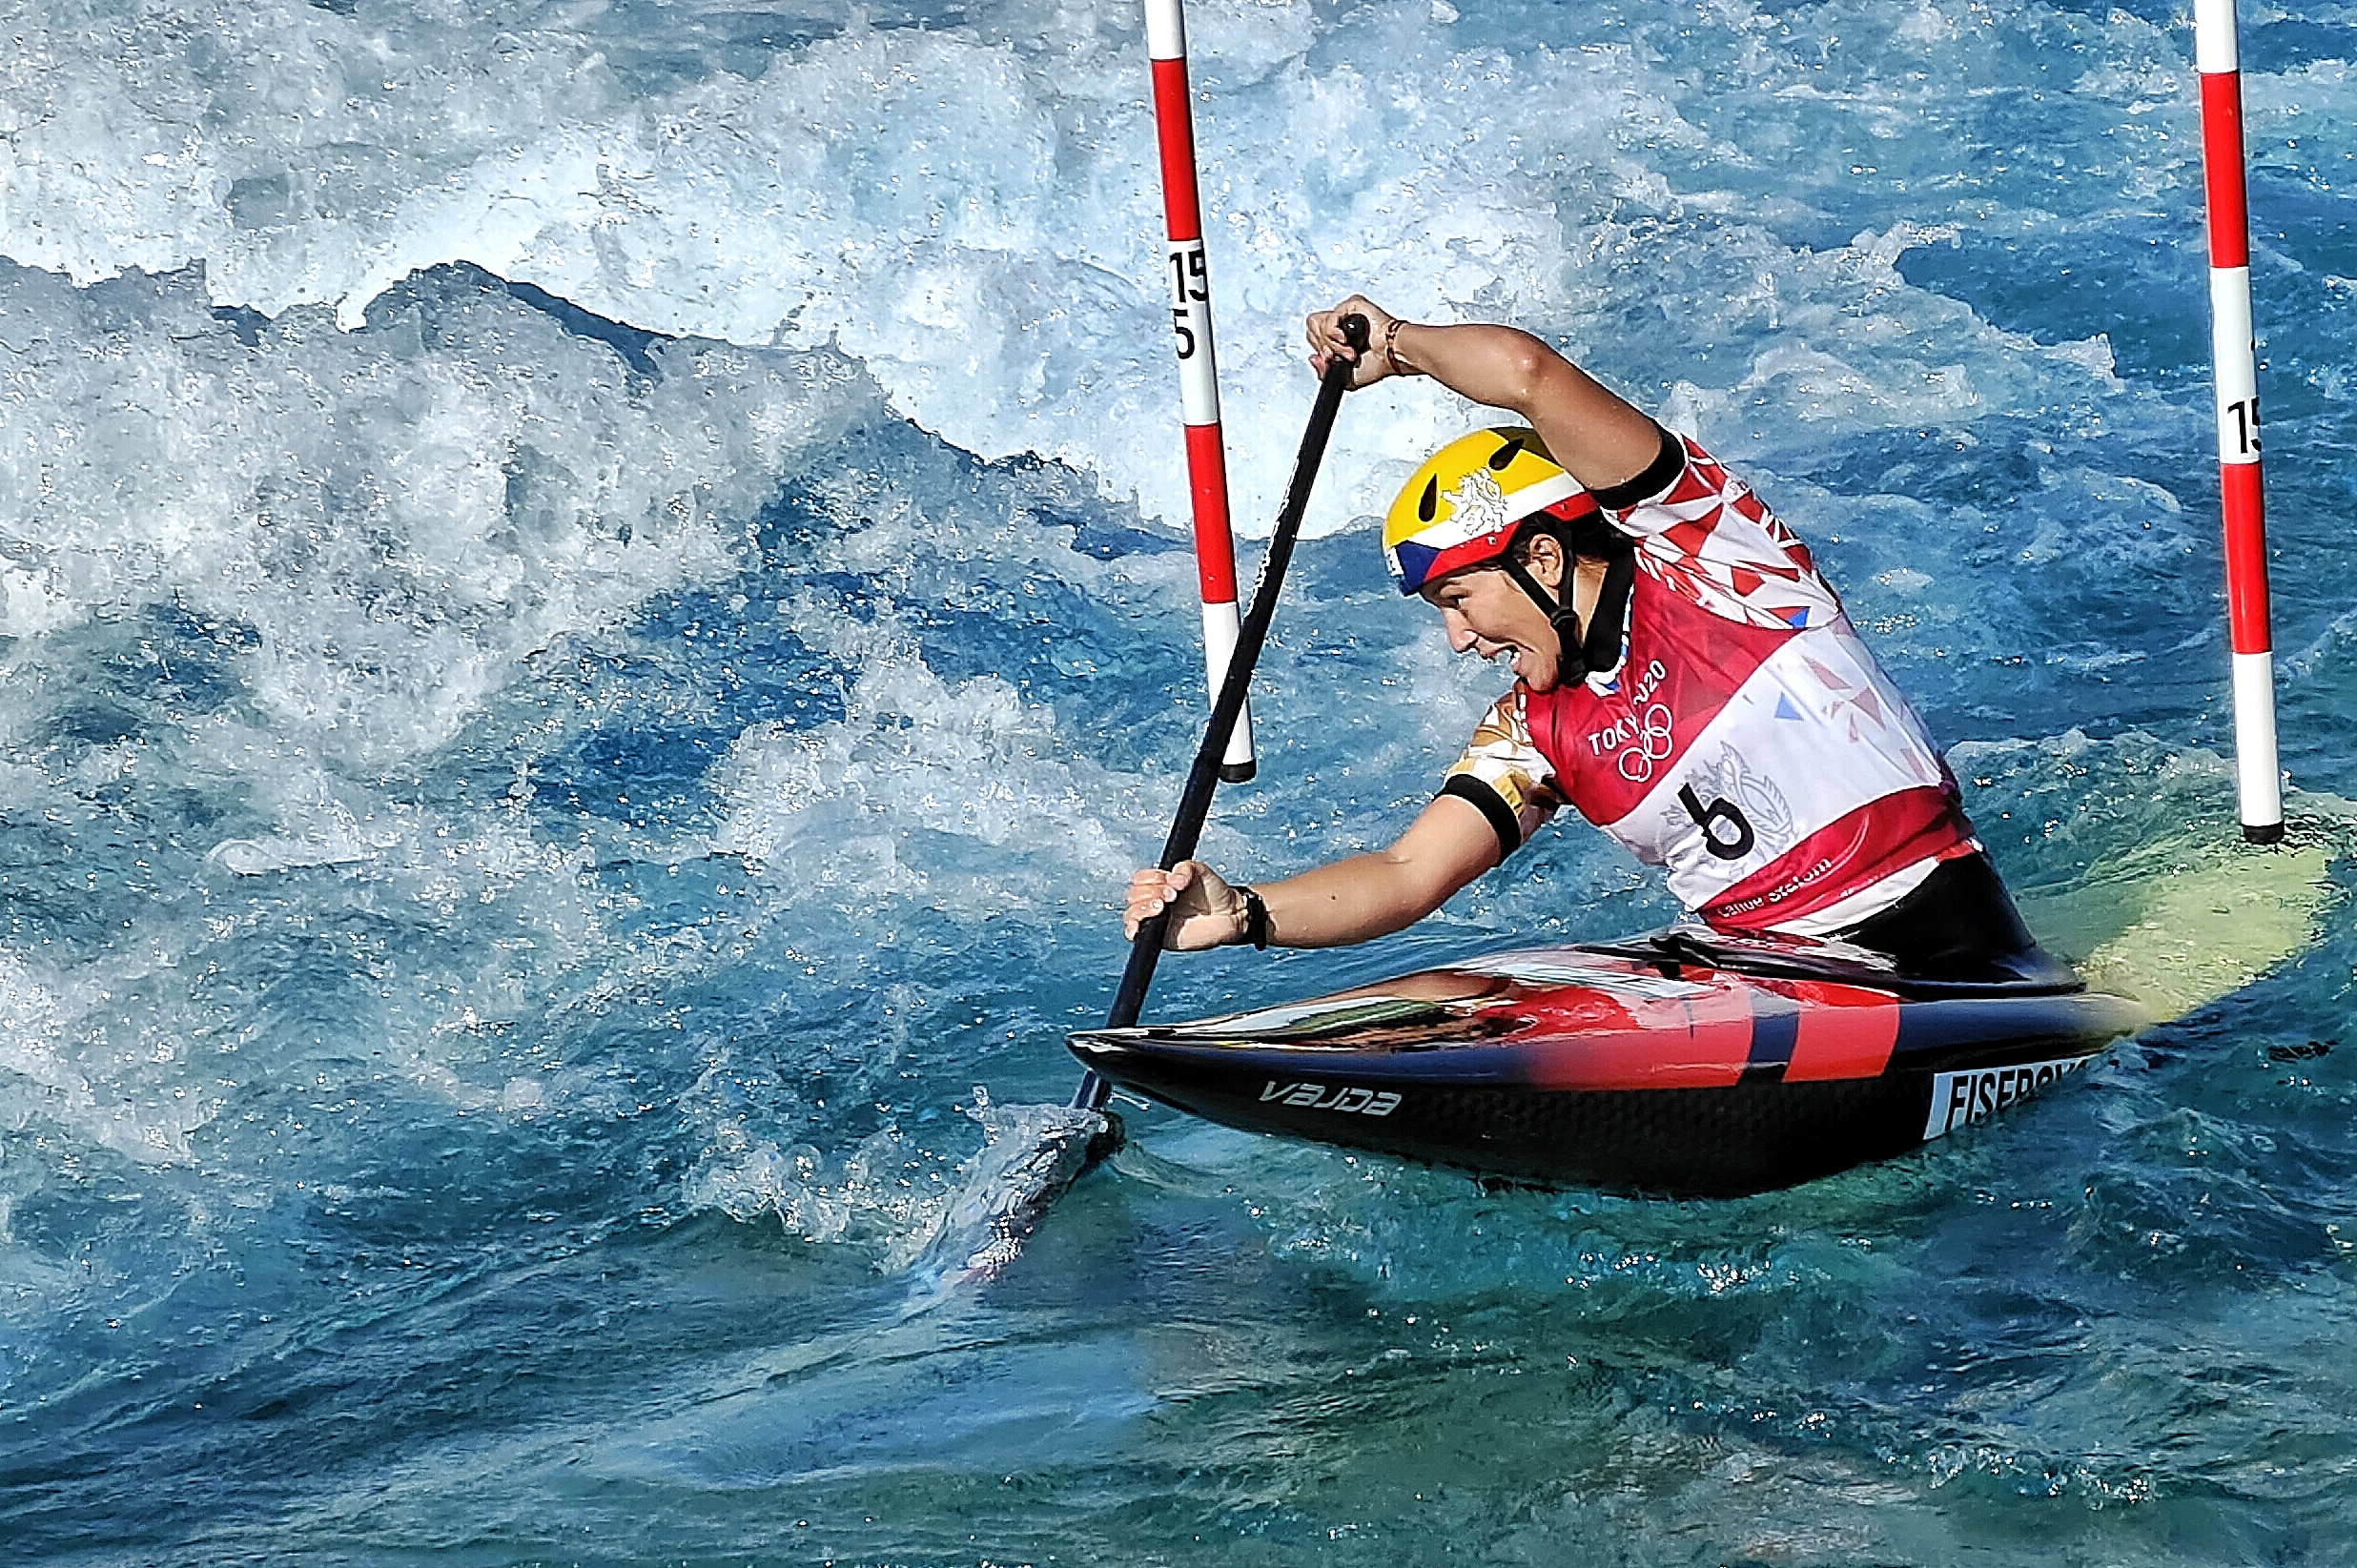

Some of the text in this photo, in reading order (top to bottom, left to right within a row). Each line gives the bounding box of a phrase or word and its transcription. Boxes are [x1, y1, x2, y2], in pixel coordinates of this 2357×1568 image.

[1169, 250, 1209, 303] 15
[1588, 714, 1640, 756] TOKY
[1677, 782, 1755, 861] 6
